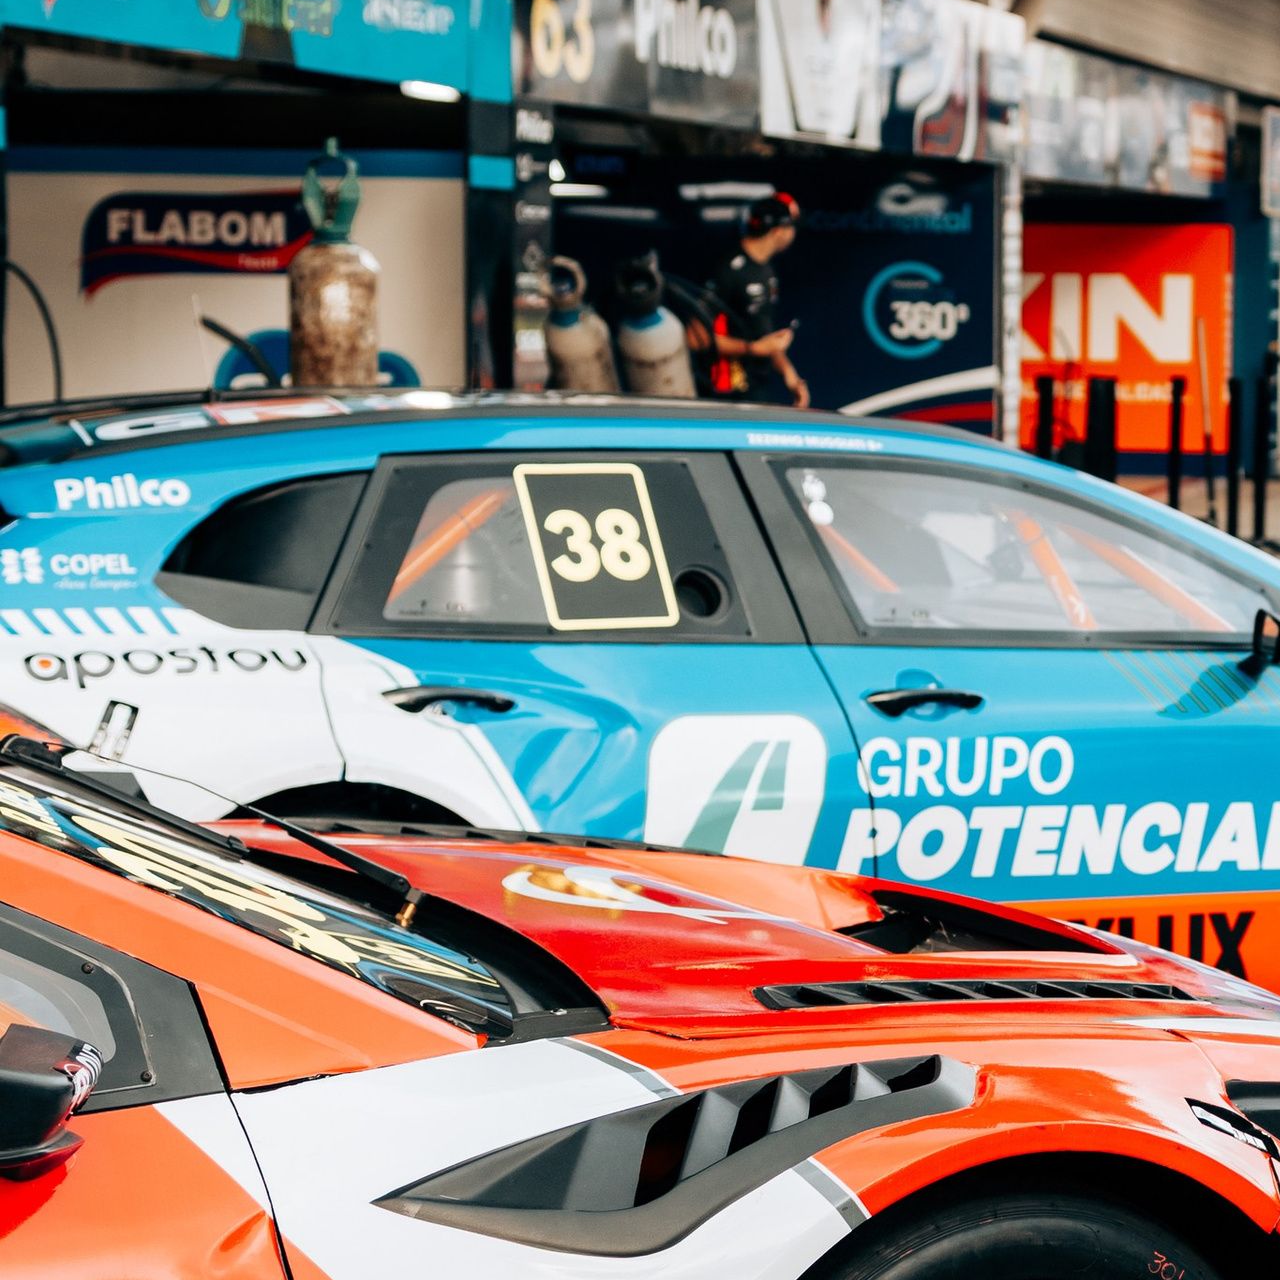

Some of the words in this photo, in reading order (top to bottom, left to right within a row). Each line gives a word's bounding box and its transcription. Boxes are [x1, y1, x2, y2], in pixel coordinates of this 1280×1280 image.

[106, 207, 287, 246] FLABOM
[1022, 272, 1194, 363] IN
[54, 472, 191, 511] Philco
[51, 554, 137, 576] COPEL
[543, 508, 651, 584] 38
[24, 646, 307, 689] apostou
[857, 736, 1073, 799] GRUPO
